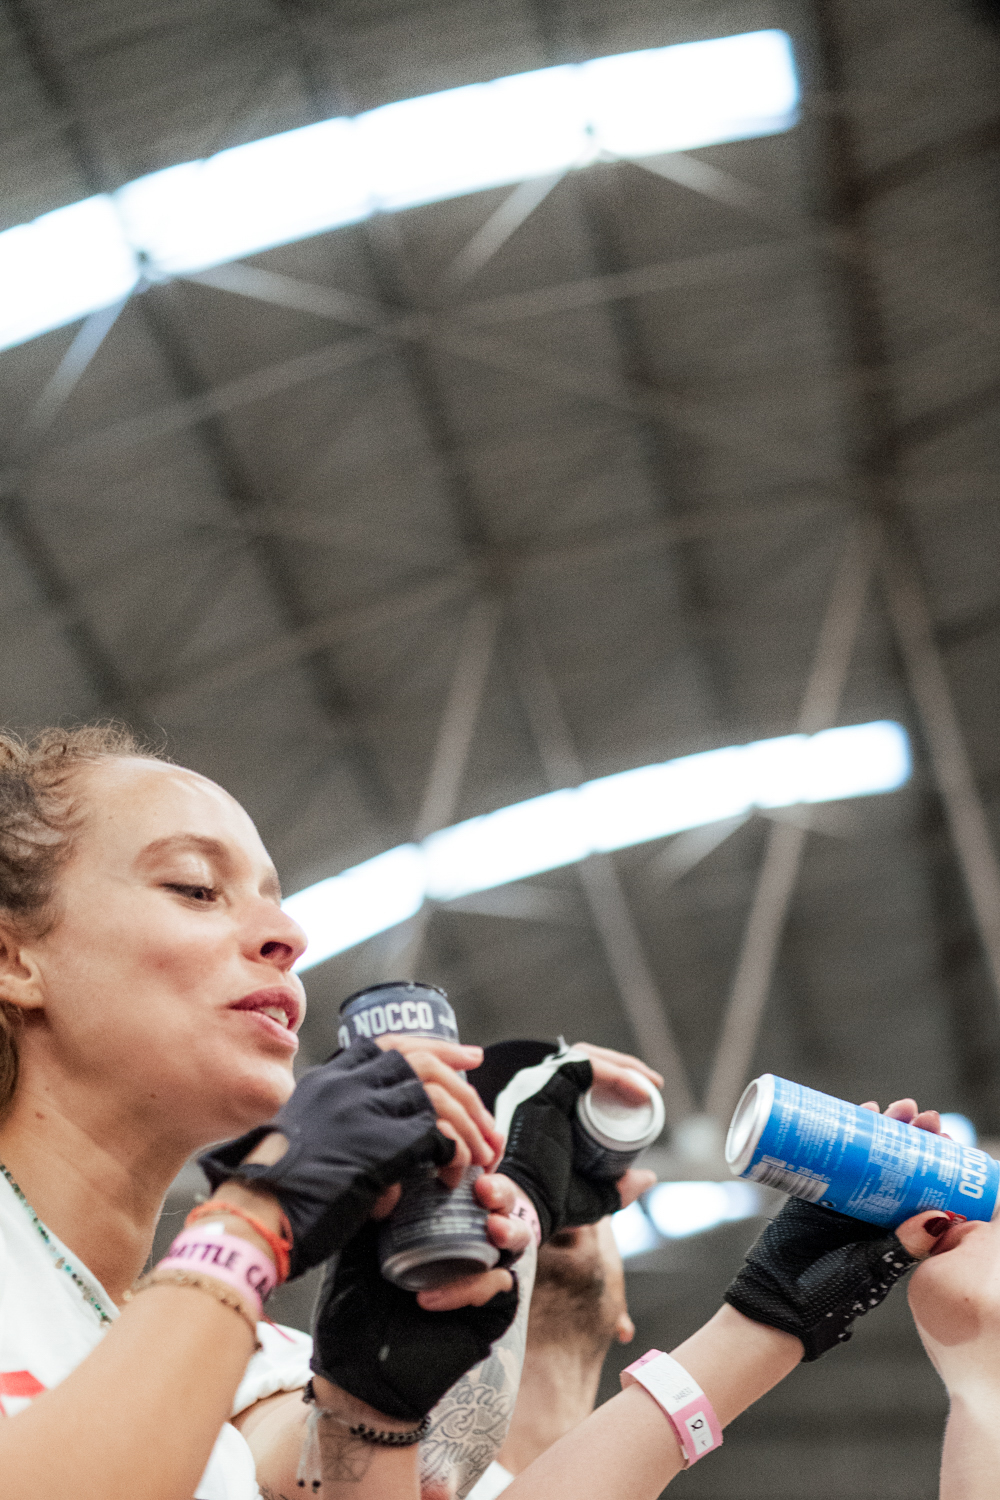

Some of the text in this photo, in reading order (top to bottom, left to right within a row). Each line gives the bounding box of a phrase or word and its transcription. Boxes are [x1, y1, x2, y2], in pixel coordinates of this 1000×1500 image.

[353, 1001, 435, 1038] NOCCO
[958, 1146, 988, 1200] OCCO
[170, 1243, 242, 1273] ATTLE
